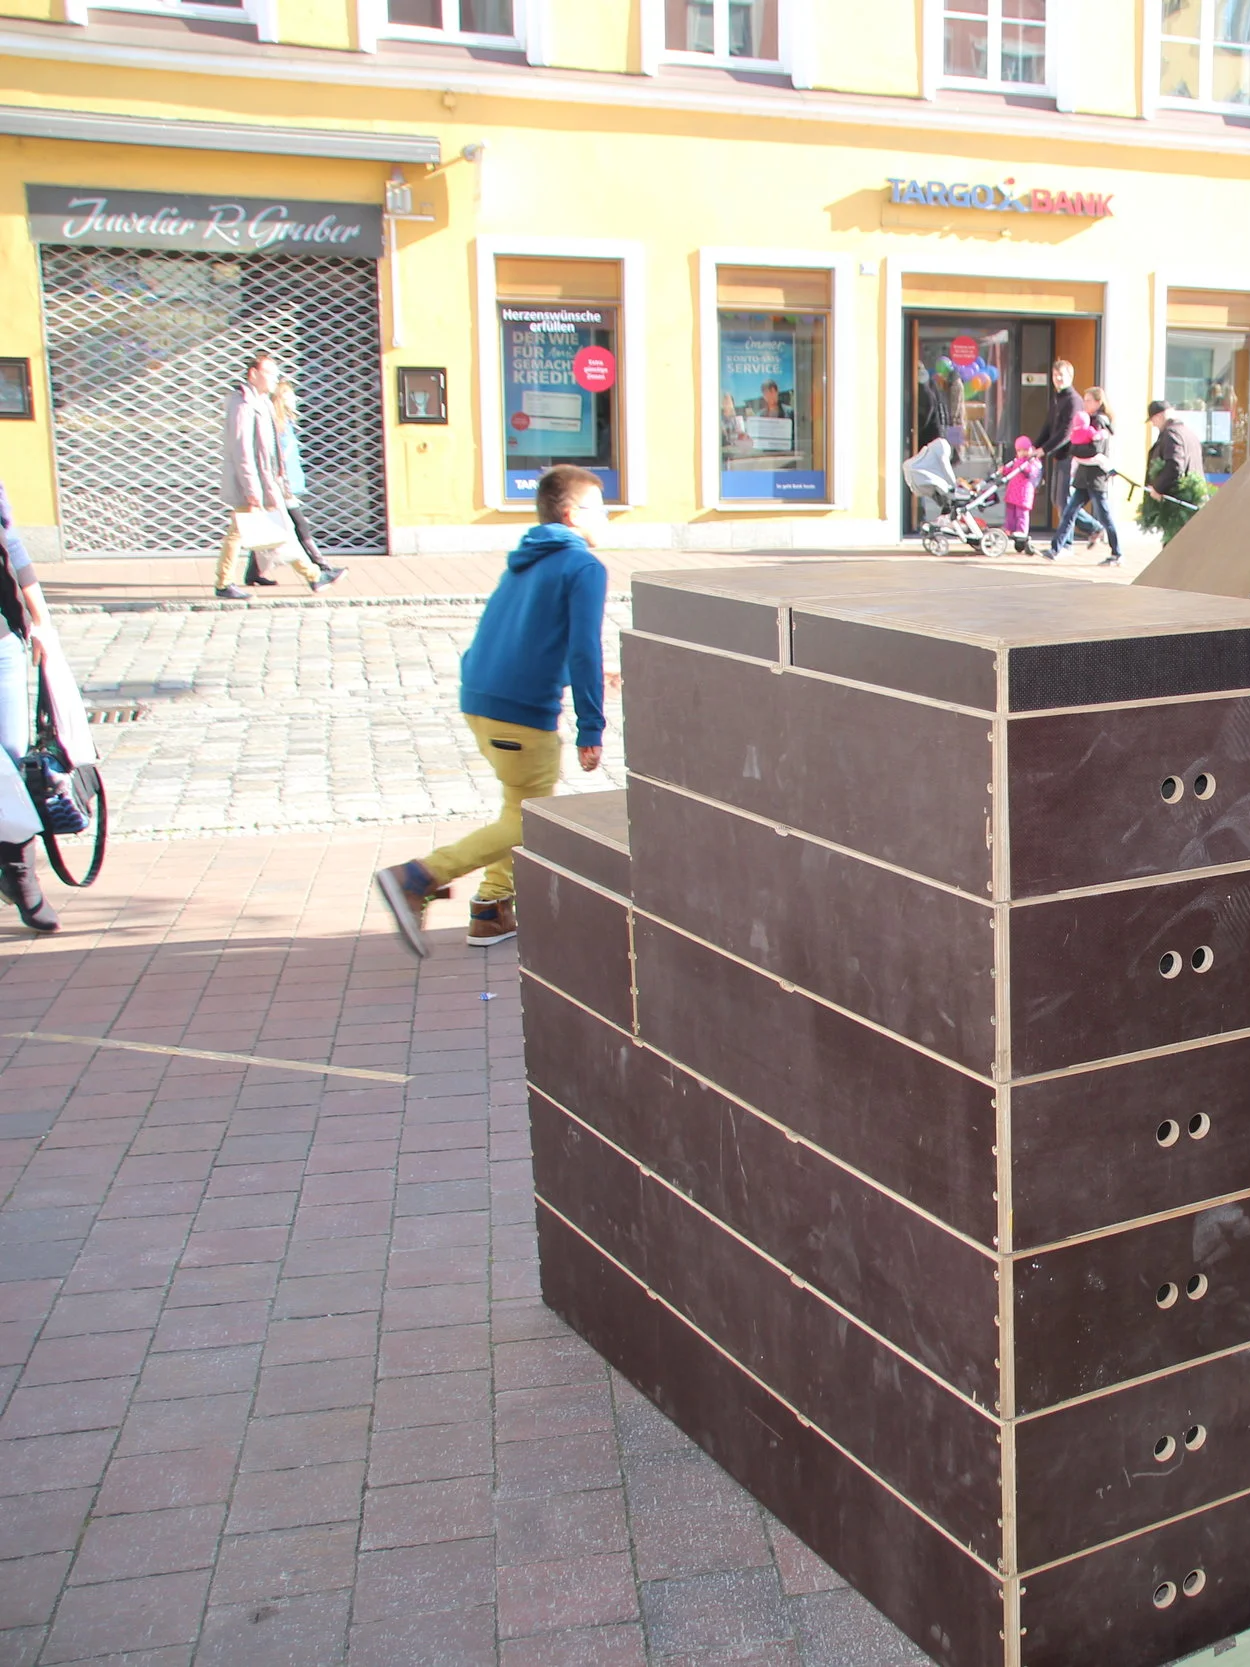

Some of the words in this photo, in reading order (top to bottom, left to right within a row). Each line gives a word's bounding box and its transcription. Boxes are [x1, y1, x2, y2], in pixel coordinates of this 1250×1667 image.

[62, 197, 198, 240] Juwelier
[203, 203, 245, 246] R.
[248, 204, 361, 249] Gruber
[502, 308, 602, 323] Herzenswünsche
[529, 320, 576, 333] erfüllen
[512, 331, 545, 345] DER
[548, 332, 580, 346] WIE
[512, 345, 545, 359] FÜR
